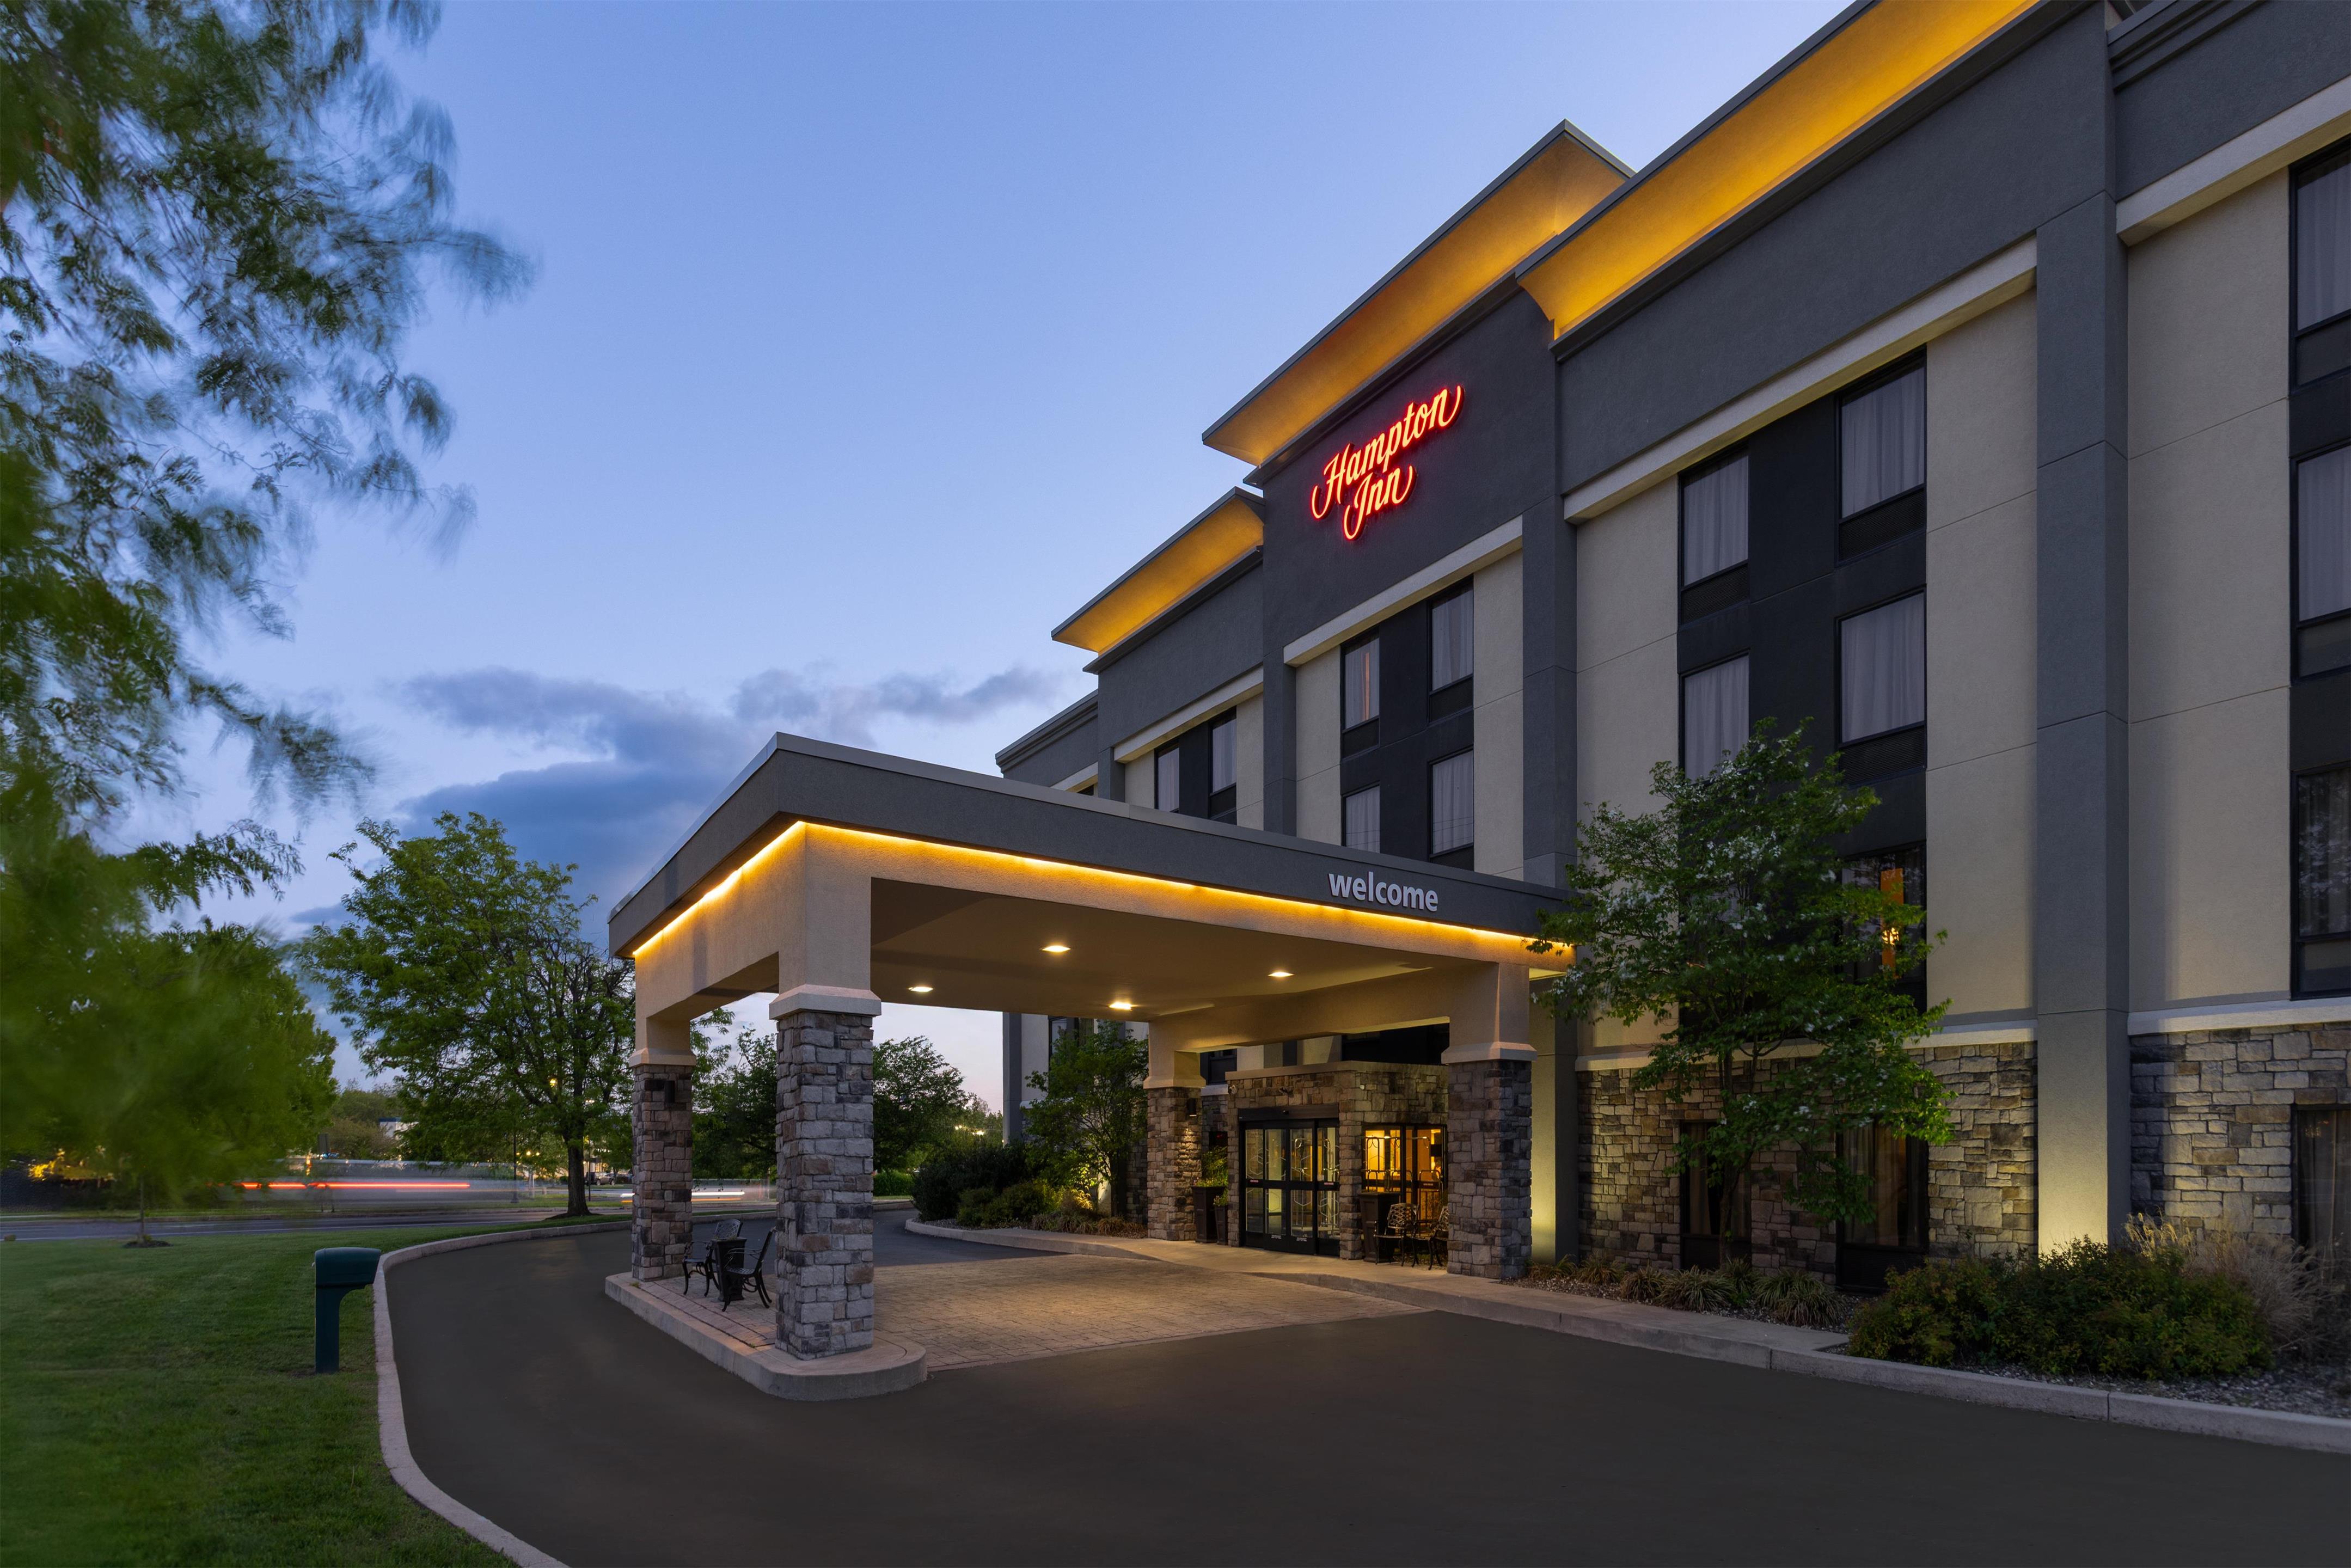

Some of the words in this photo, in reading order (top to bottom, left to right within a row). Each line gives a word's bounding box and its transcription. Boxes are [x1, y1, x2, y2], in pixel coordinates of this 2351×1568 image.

[1311, 384, 1465, 519] Hampton
[1343, 465, 1416, 540] Inn
[1328, 871, 1438, 912] welcome
